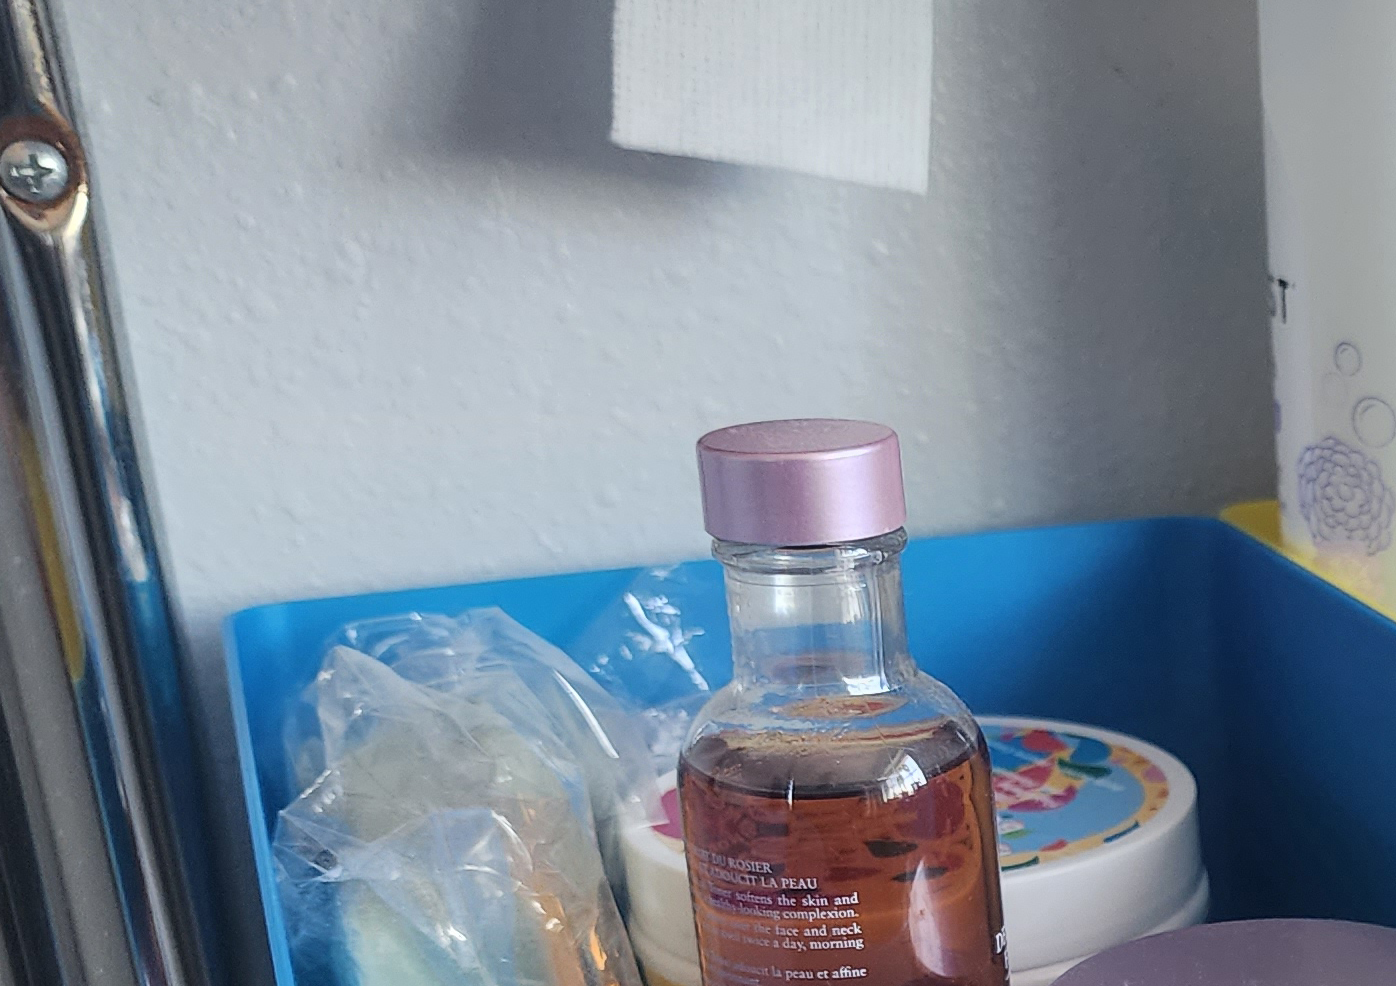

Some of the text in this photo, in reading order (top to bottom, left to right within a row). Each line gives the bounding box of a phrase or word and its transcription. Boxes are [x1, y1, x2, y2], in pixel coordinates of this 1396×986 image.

[728, 857, 773, 874] ROSIER
[761, 876, 779, 889] LA
[780, 878, 818, 890] PEAU
[735, 890, 773, 905] softens
[777, 893, 797, 906] the
[802, 893, 829, 907] skin
[834, 892, 860, 906] and
[783, 906, 860, 922] complexion.
[775, 923, 799, 937] face
[803, 924, 828, 937] and
[832, 922, 863, 936] neck
[782, 938, 808, 952] day,
[809, 936, 865, 951] morning
[772, 965, 782, 978] la
[785, 969, 815, 981] peau
[817, 967, 830, 980] et
[831, 965, 868, 979] affine
